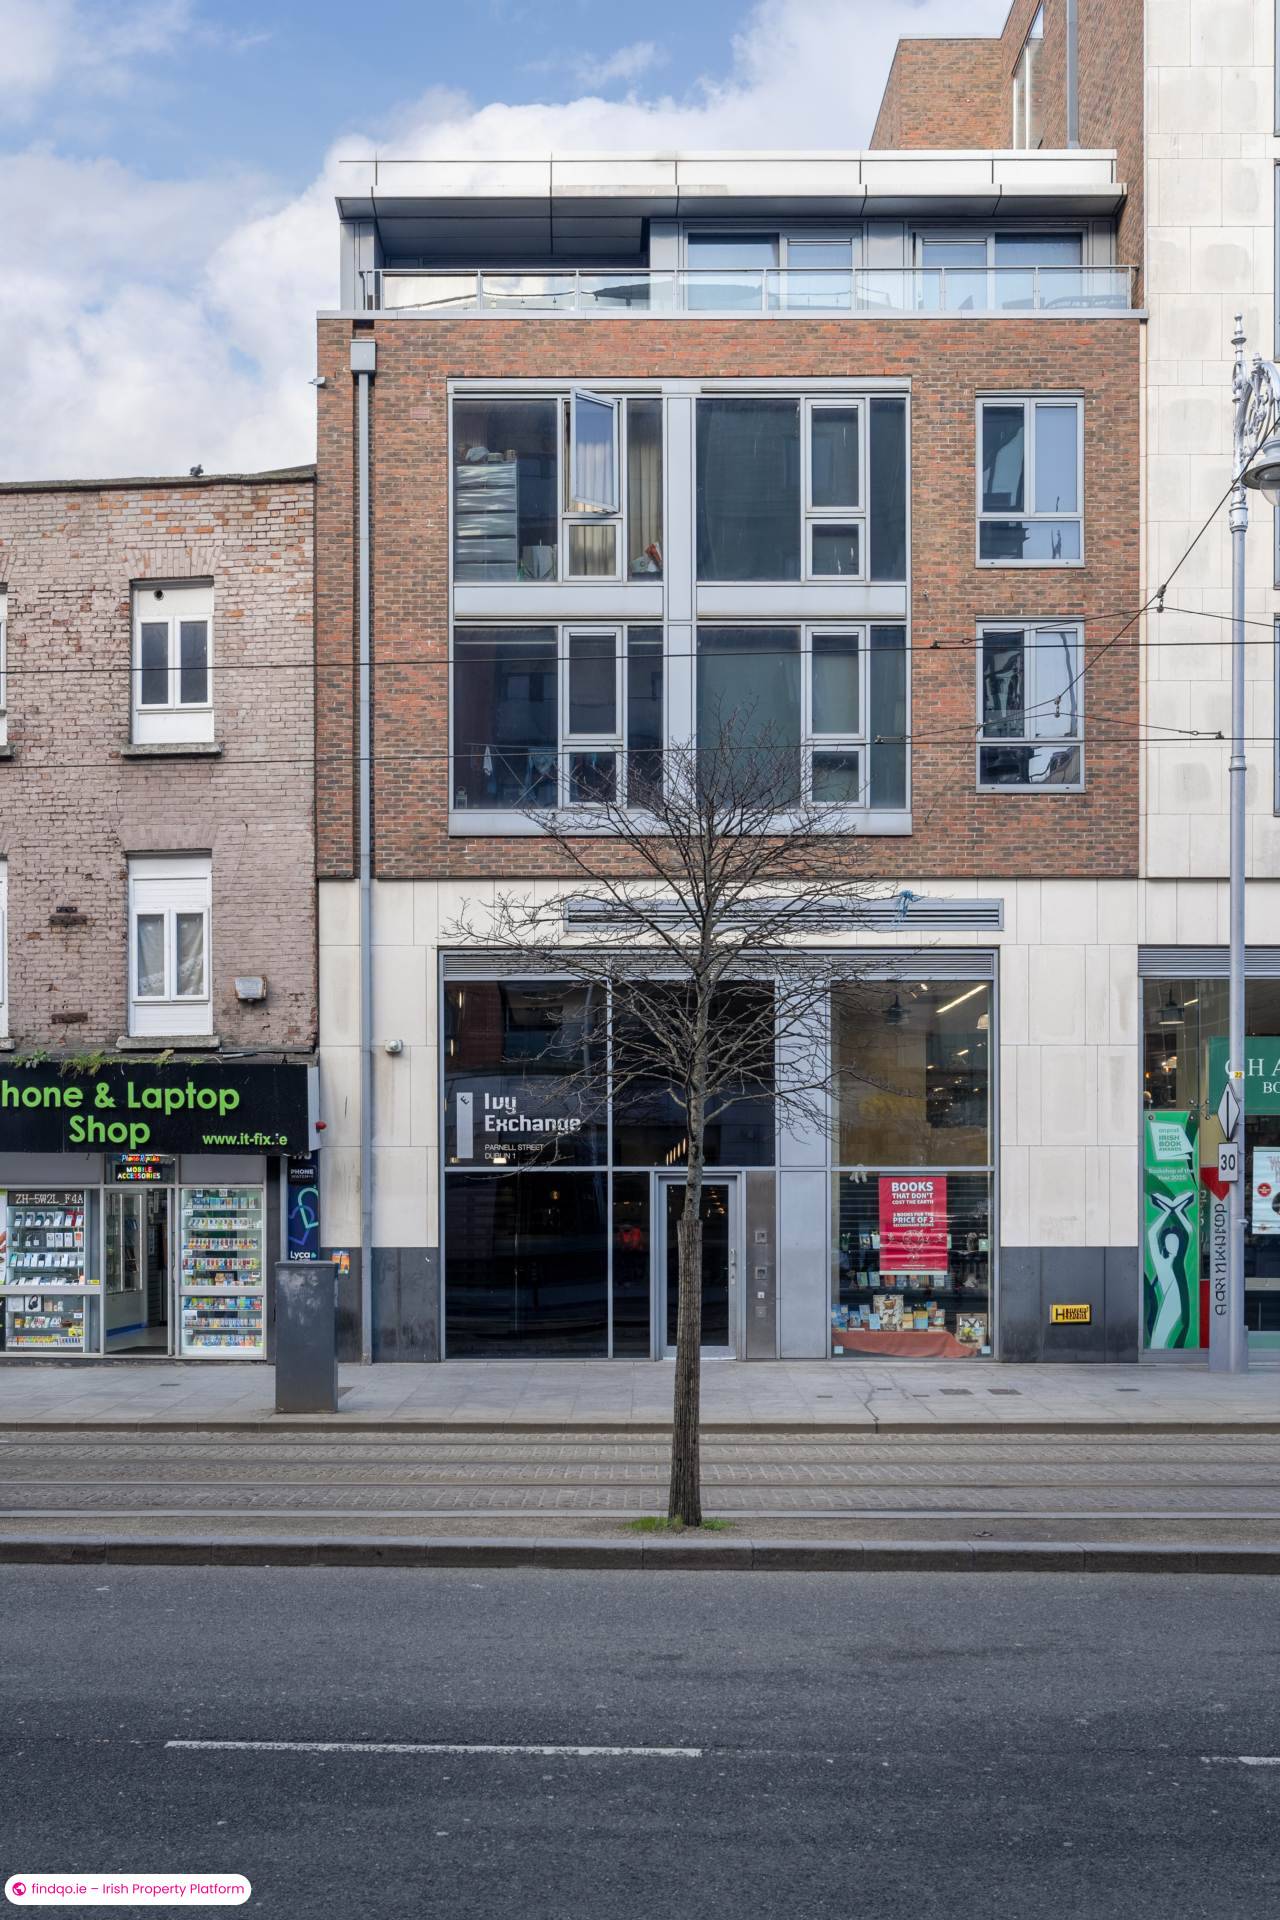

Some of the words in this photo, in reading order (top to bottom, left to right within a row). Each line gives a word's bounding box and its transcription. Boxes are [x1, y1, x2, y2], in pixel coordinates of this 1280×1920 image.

[2, 1080, 83, 1107] hone
[95, 1082, 117, 1108] &
[128, 1081, 240, 1116] Laptop
[484, 1092, 517, 1115] Ivy
[69, 1115, 150, 1150] Shop
[484, 1114, 581, 1136] Exchange
[1220, 1154, 1236, 1171] 30
[891, 1182, 934, 1192] BOOKS
[290, 1251, 311, 1260] Lyca
